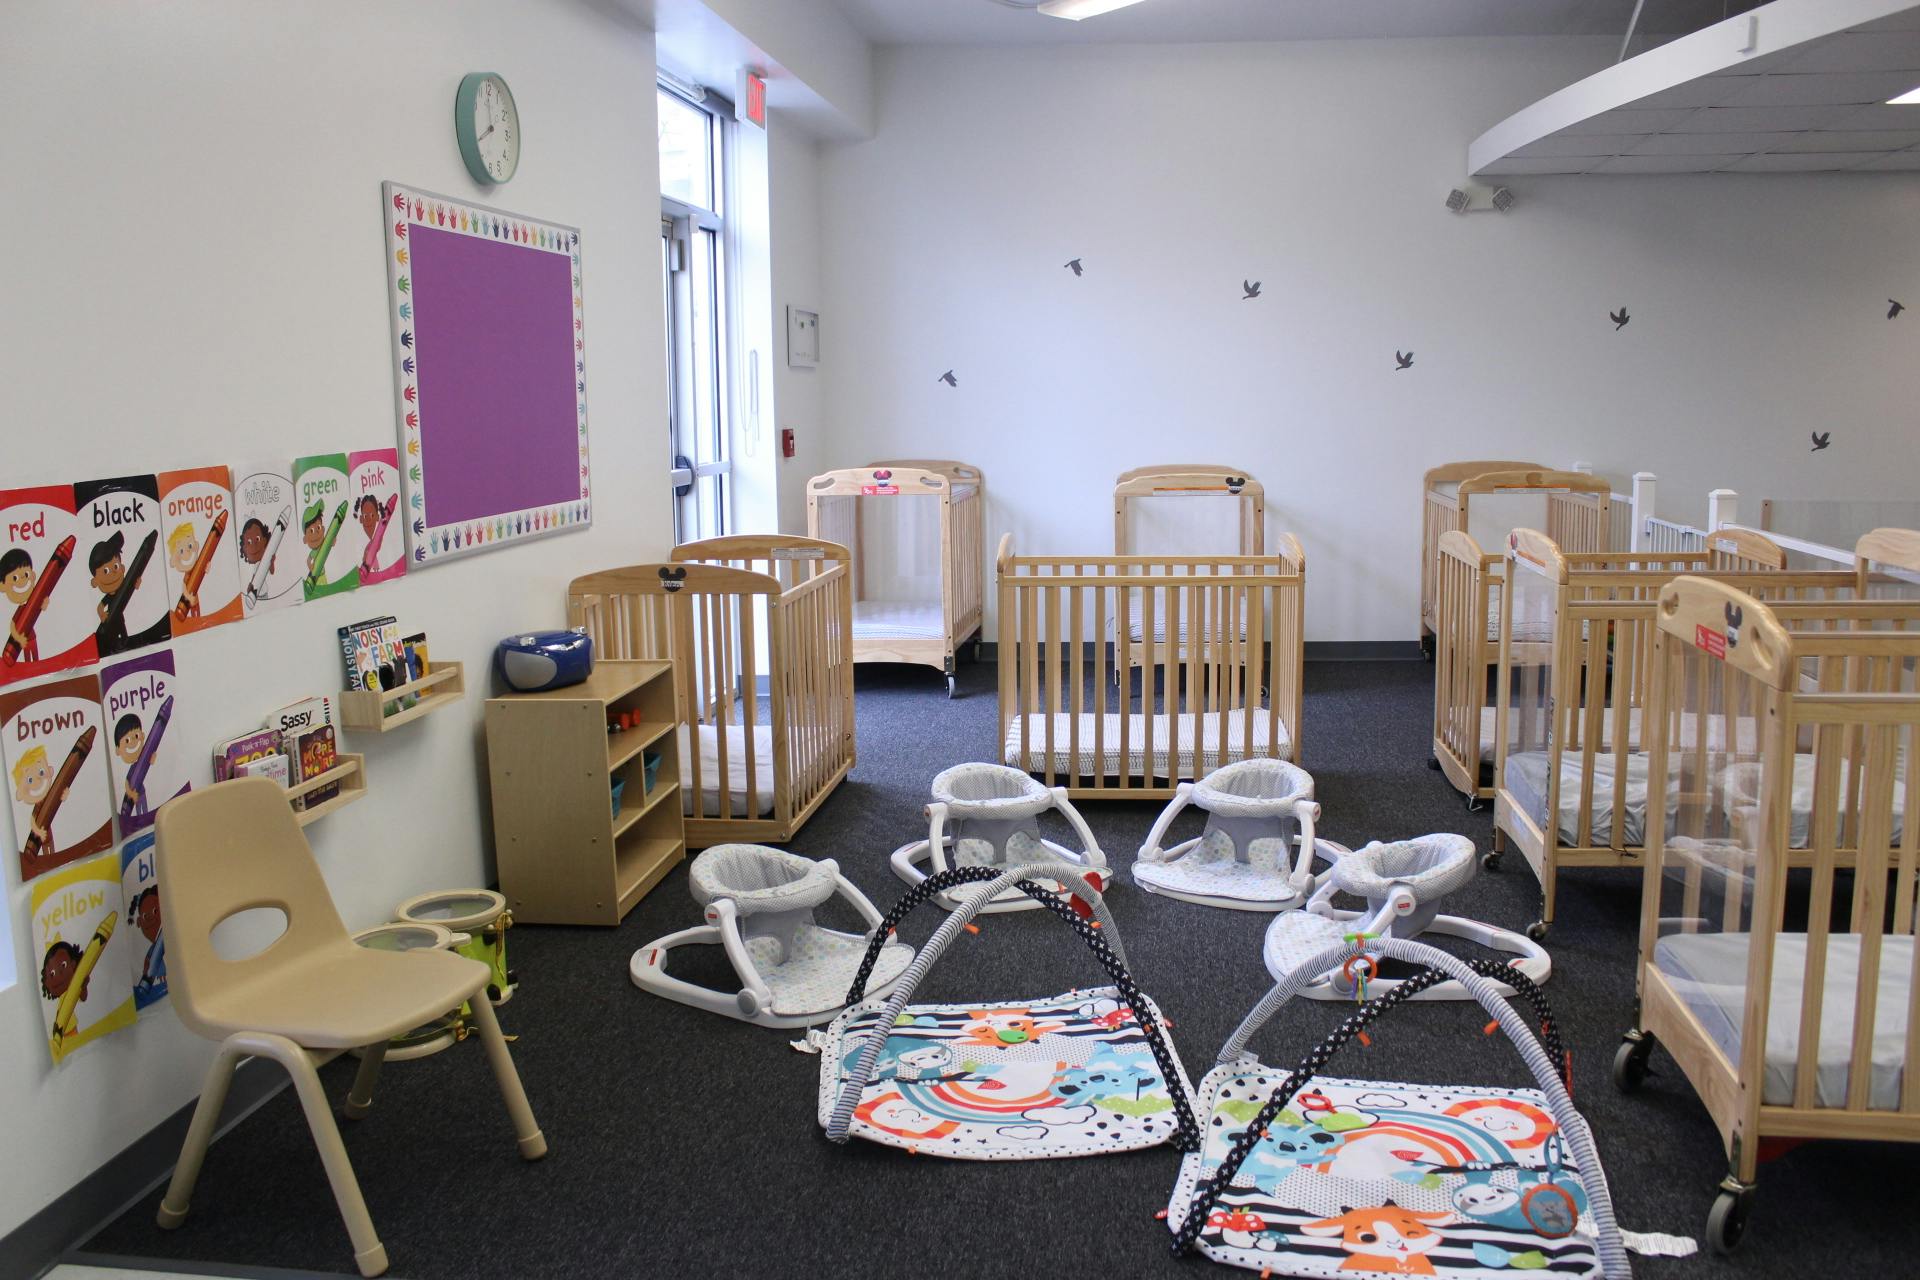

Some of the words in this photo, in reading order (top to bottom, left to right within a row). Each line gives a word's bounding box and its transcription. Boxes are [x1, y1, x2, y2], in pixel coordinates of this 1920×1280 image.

[244, 481, 280, 504] white
[303, 478, 338, 504] green
[360, 466, 385, 493] pink
[93, 497, 145, 528] black
[168, 494, 223, 519] orange
[9, 511, 45, 542] red
[352, 627, 383, 650] NOISY
[341, 637, 357, 671] NOISY
[371, 641, 404, 667] FARM
[109, 674, 165, 720] purple
[17, 709, 84, 742] brown
[280, 710, 312, 732] Sassy
[138, 853, 155, 883] bl
[41, 889, 104, 938] yellow
